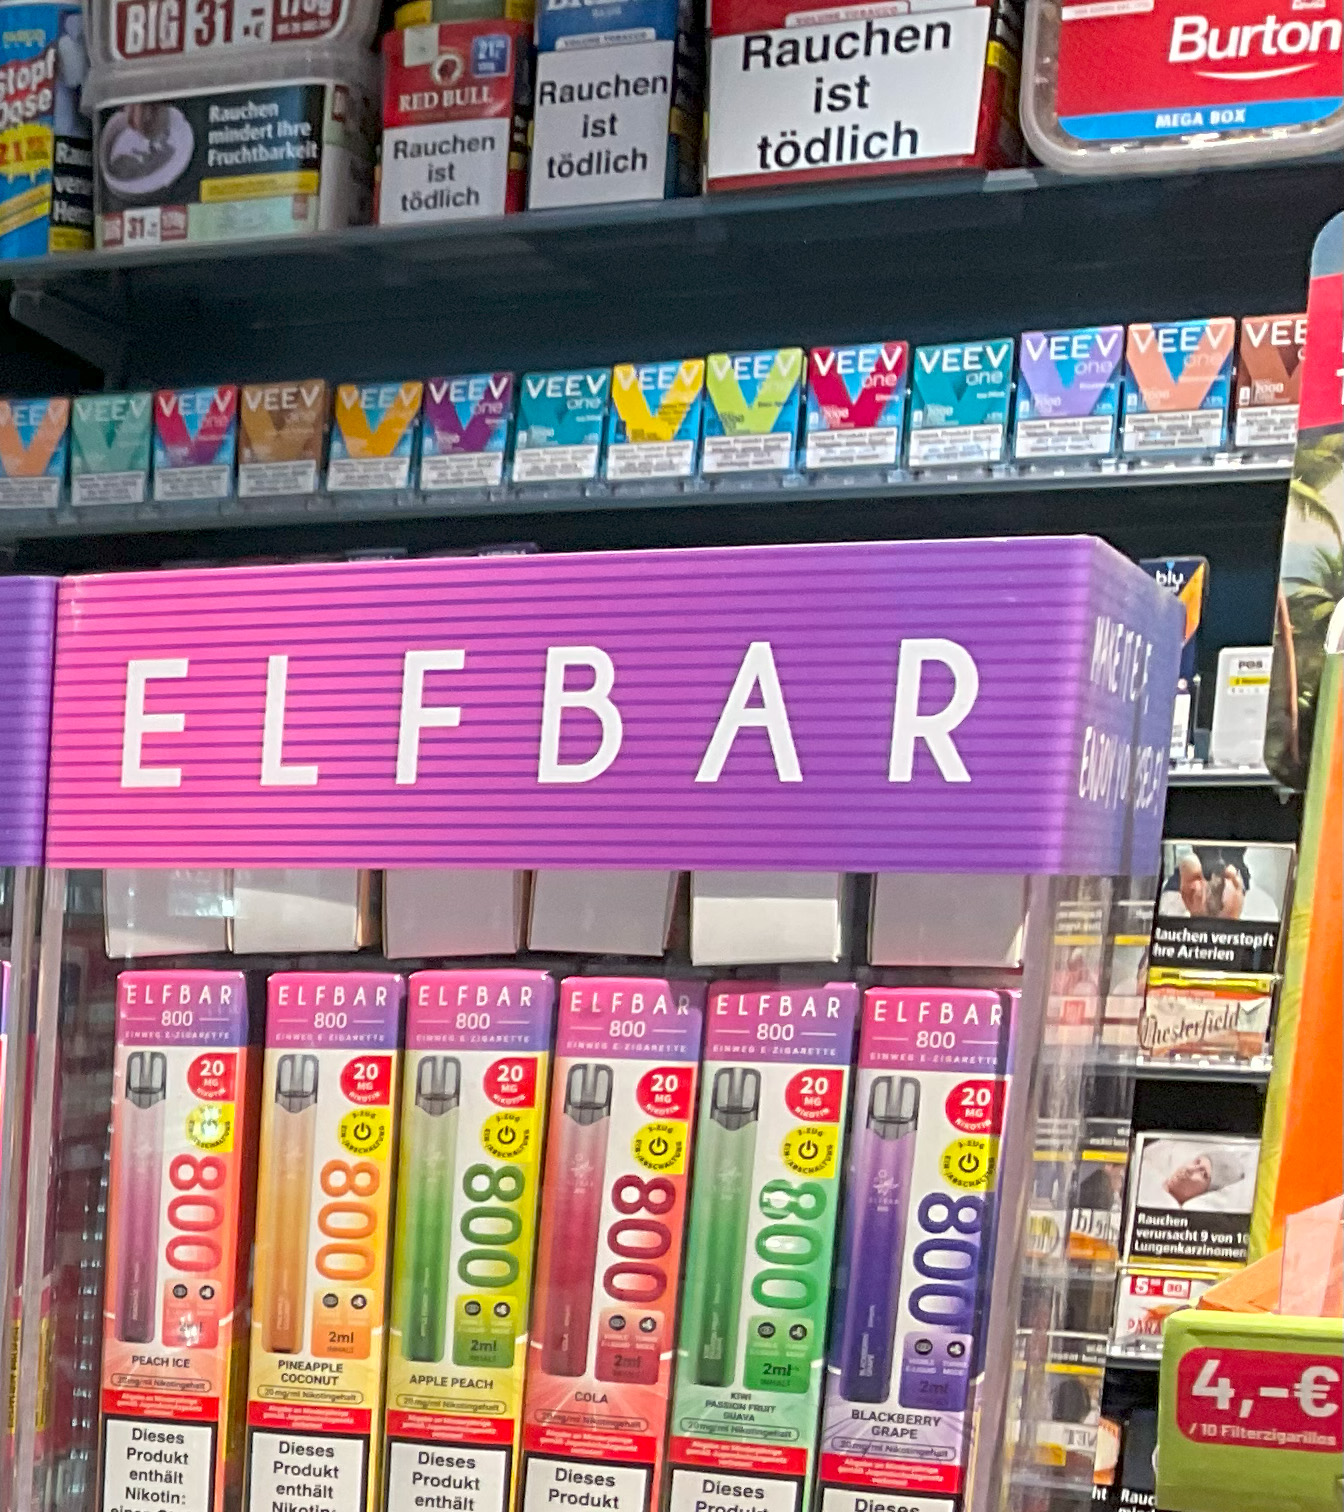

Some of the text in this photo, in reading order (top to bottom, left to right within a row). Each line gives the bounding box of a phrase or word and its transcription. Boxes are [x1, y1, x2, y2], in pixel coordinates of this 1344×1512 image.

[125, 0, 180, 54] BIG
[742, 20, 952, 70] Rauchen
[1169, 16, 1342, 64] Burton
[539, 70, 668, 105] Rauchen
[814, 75, 870, 114] ist
[400, 86, 494, 112] RED BULL
[582, 112, 618, 139] ist
[1155, 109, 1205, 129] MEGA
[392, 132, 496, 160] Rauchen
[758, 121, 919, 170] tödlich
[428, 162, 454, 183] ist
[547, 148, 648, 179] tödlich
[401, 185, 480, 211] tödlich
[813, 346, 903, 376] VEEV
[429, 377, 509, 402] VEEV
[526, 374, 607, 398] VEEV
[243, 386, 321, 412] VEEV
[120, 638, 980, 788] ELFBAR
[1211, 930, 1275, 949] verstopft
[1178, 946, 1235, 961] Arterien
[278, 984, 389, 1007] ELFBAR
[418, 984, 533, 1008] ELFBAR
[314, 1010, 347, 1030] 800
[352, 1061, 380, 1082] 20
[315, 1160, 382, 1281] 800
[1138, 1212, 1188, 1227] Rauchen
[1136, 1228, 1233, 1243] verursacht 9 von
[328, 1330, 355, 1345] 2ml
[131, 1356, 190, 1369] PEACH ICE
[278, 1359, 343, 1374] PINEAPPLE
[281, 1372, 339, 1387] COCONUT
[410, 1374, 493, 1391] APPLE PEACH
[575, 1391, 608, 1405] COLA
[851, 1409, 941, 1427] BLACKBERRY
[871, 1425, 918, 1441] GRAPE
[1222, 1425, 1336, 1446] Filterzigarillos
[278, 1441, 335, 1459] Dieses
[273, 1460, 339, 1480] Produkt
[276, 1480, 333, 1500] enthält
